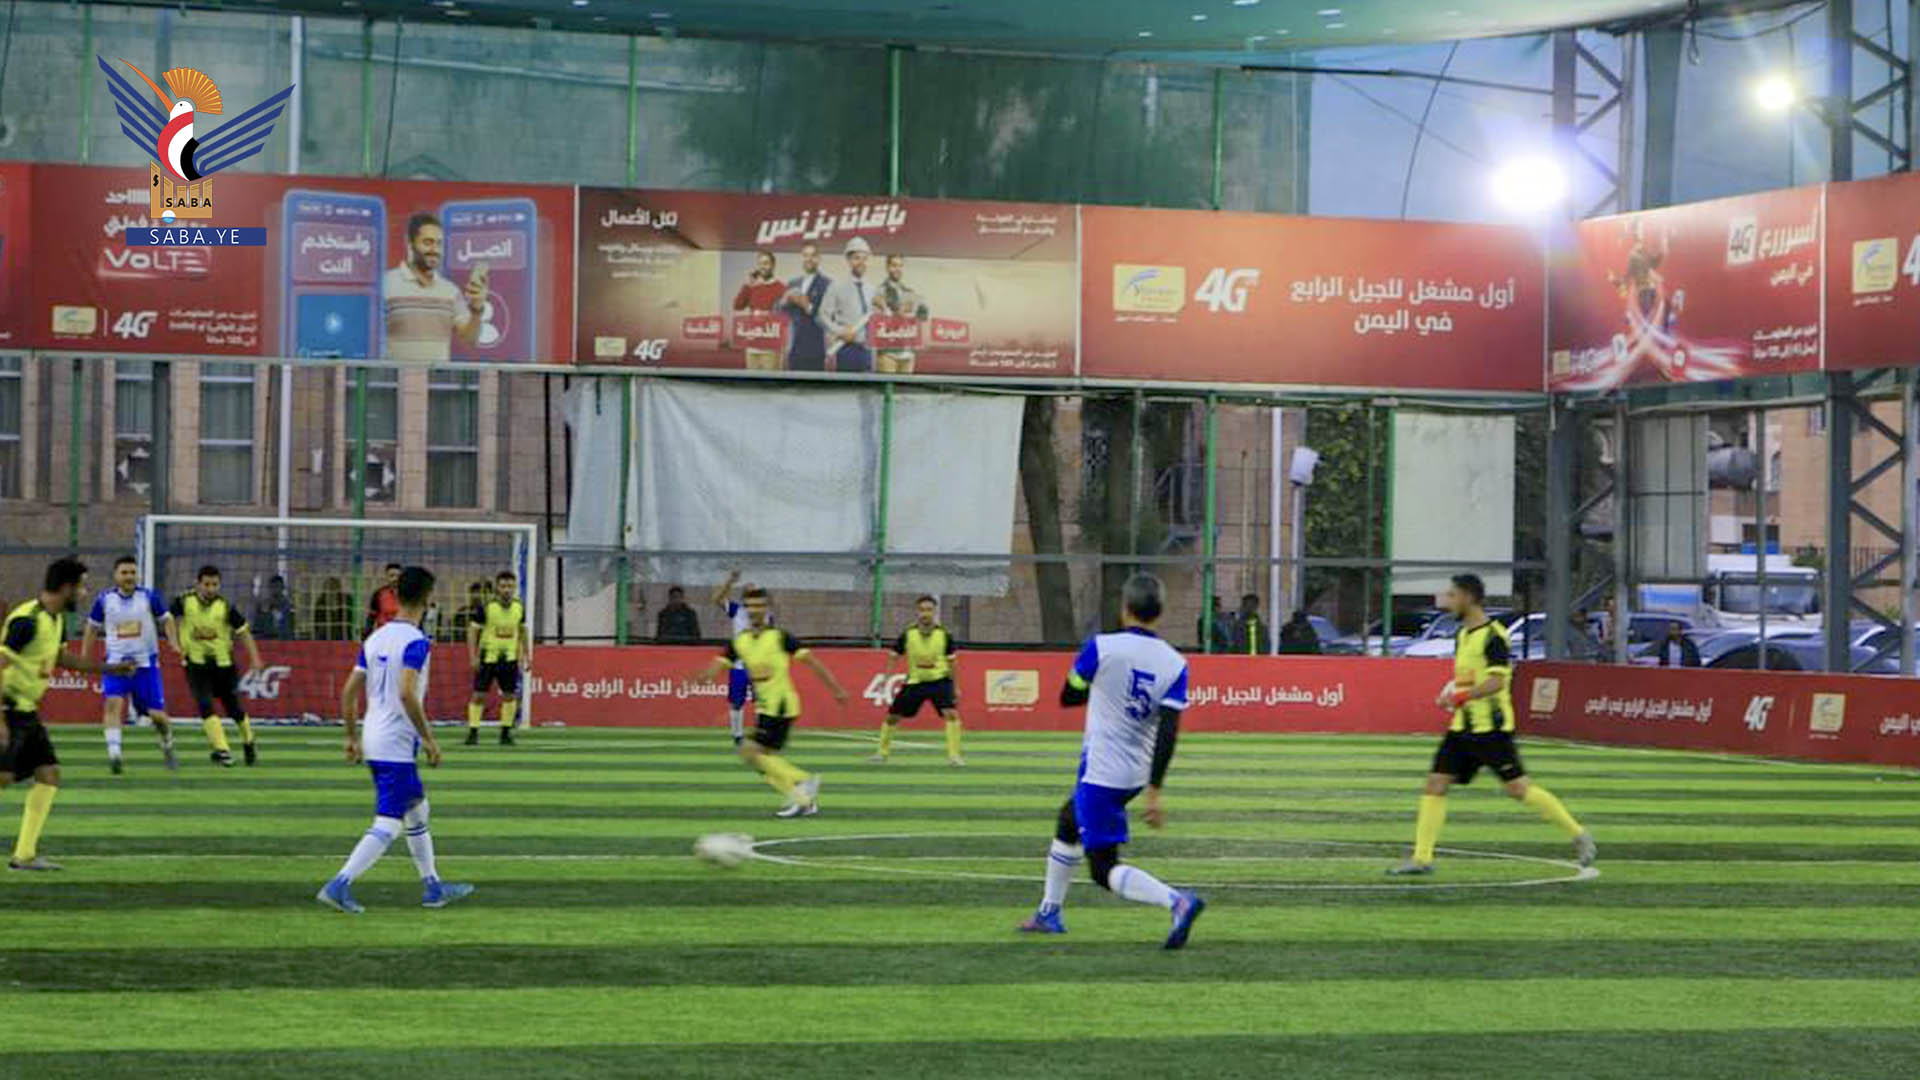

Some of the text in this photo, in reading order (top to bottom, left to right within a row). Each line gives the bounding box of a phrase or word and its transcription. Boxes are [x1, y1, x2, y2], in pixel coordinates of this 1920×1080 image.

[756, 202, 907, 244] باقات بزنس
[301, 232, 371, 256] واستخدم
[319, 256, 353, 275] النت
[1195, 267, 1261, 313] 4G
[1289, 276, 1515, 310] أول مشغل للجيل الرابع
[112, 310, 158, 339] 4G
[1354, 310, 1454, 336] في اليمن
[634, 339, 668, 361] 4G
[237, 665, 291, 699] 4G
[377, 655, 389, 705] 7
[547, 678, 578, 698] في
[581, 678, 624, 698] الرابع
[627, 679, 672, 698] للجيل
[1125, 668, 1156, 721] 5
[1185, 682, 1344, 707] أول مشغل للجيل الراب
[1743, 694, 1775, 732] 4G
